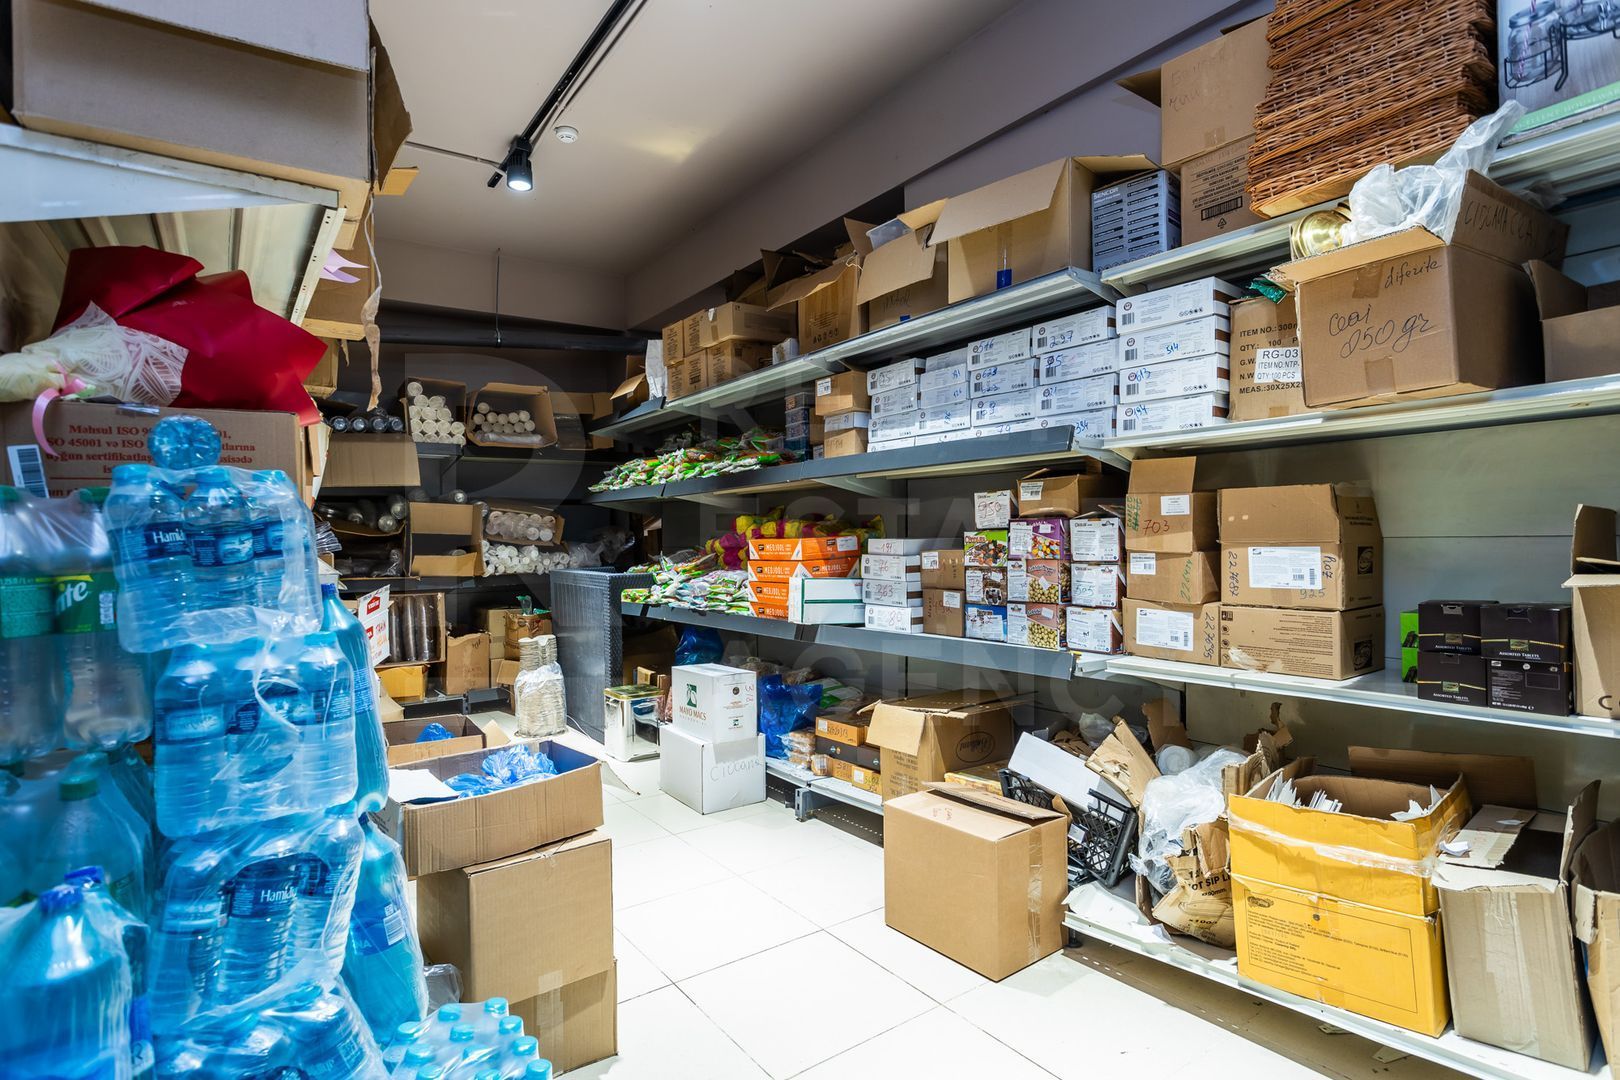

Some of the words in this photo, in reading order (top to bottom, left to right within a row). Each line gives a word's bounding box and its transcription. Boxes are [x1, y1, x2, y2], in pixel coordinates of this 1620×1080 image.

[1239, 328, 1259, 338] ITEM
[1268, 339, 1282, 347] 100
[1258, 361, 1273, 370] ITEM
[1282, 371, 1296, 379] PCS
[116, 425, 141, 436] ISO
[67, 438, 102, 448] 45001
[121, 439, 145, 449] ISO
[1142, 519, 1170, 536] 703
[153, 528, 186, 545] Hamid
[766, 543, 785, 552] MEDJOOL
[764, 565, 783, 574] MEDJOOL
[763, 586, 780, 595] MEDJOOL
[1206, 876, 1220, 887] SIP
